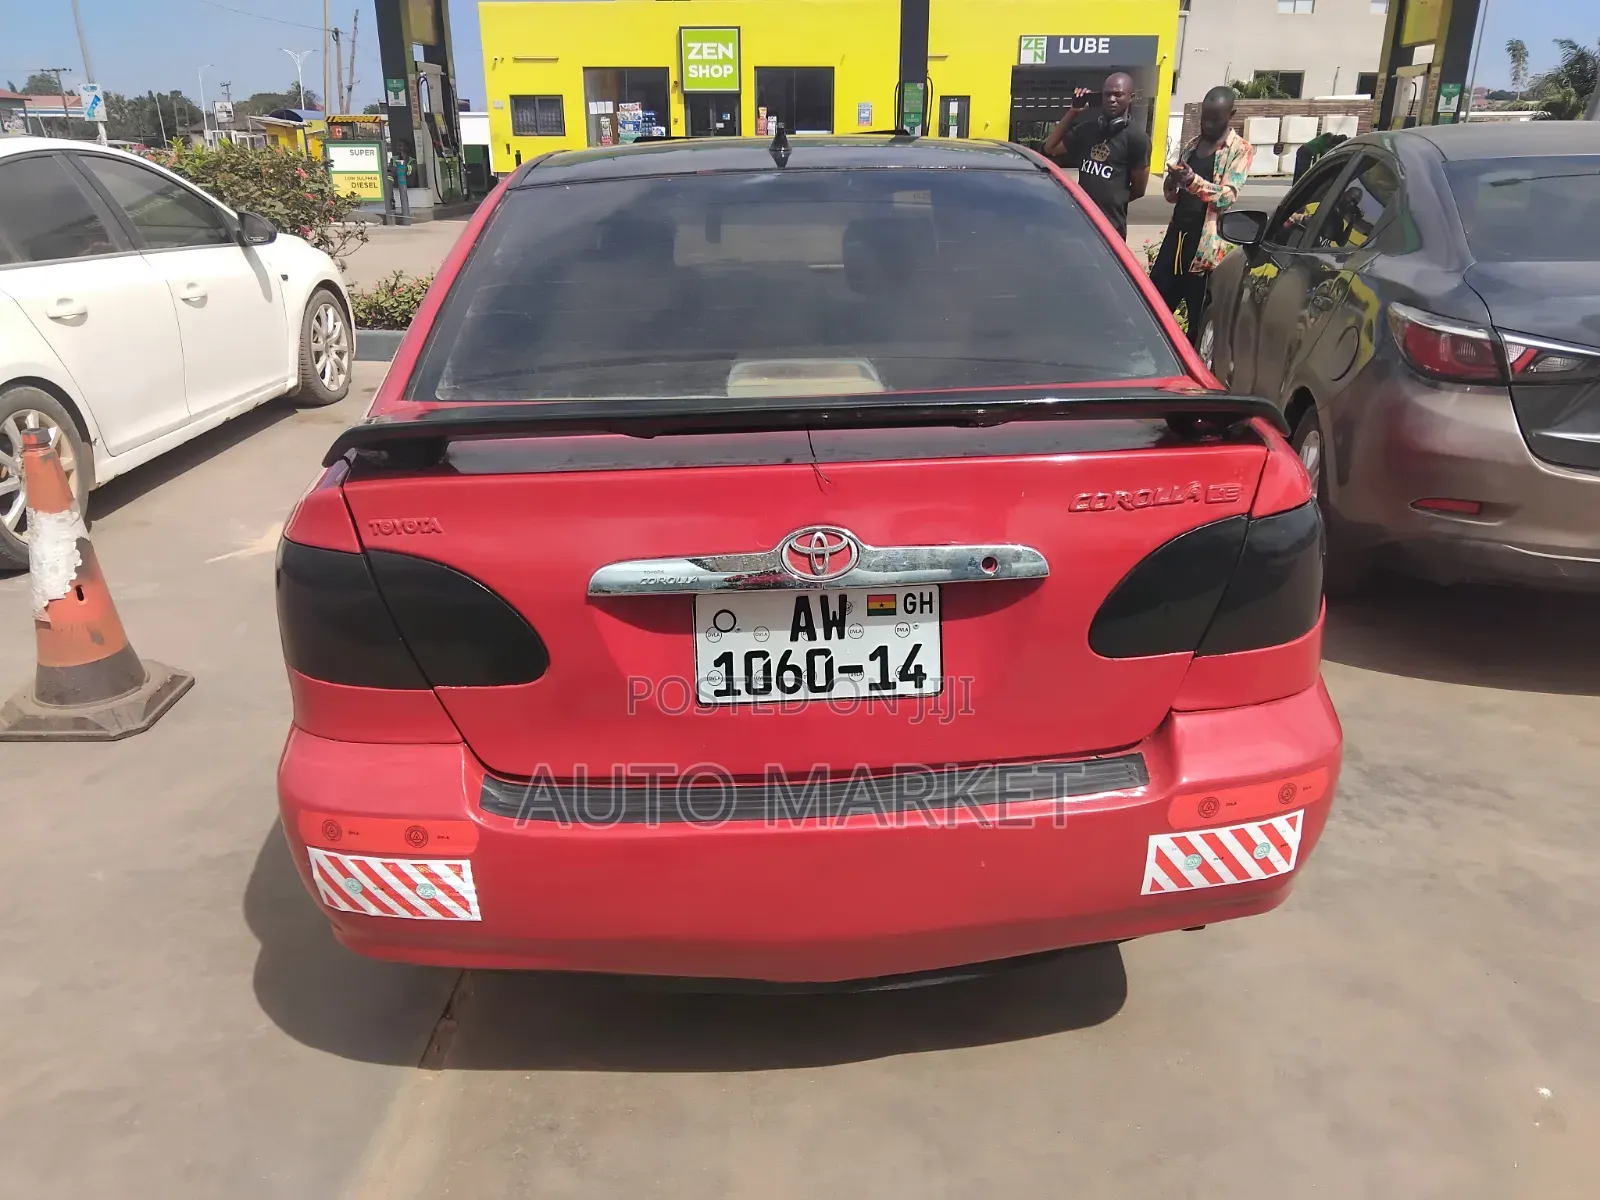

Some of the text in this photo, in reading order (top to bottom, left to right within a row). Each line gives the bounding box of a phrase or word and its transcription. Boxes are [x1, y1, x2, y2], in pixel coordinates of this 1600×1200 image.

[687, 42, 734, 60] ZEN
[1058, 37, 1110, 54] LUBE
[688, 64, 734, 78] SHOP
[1081, 158, 1113, 179] KING
[1068, 480, 1201, 512] COROLLA
[368, 517, 443, 536] TOYOTA
[638, 576, 700, 586] COROLLA
[903, 591, 933, 615] GH
[789, 594, 848, 642] AW
[713, 643, 927, 698] 1060-14
